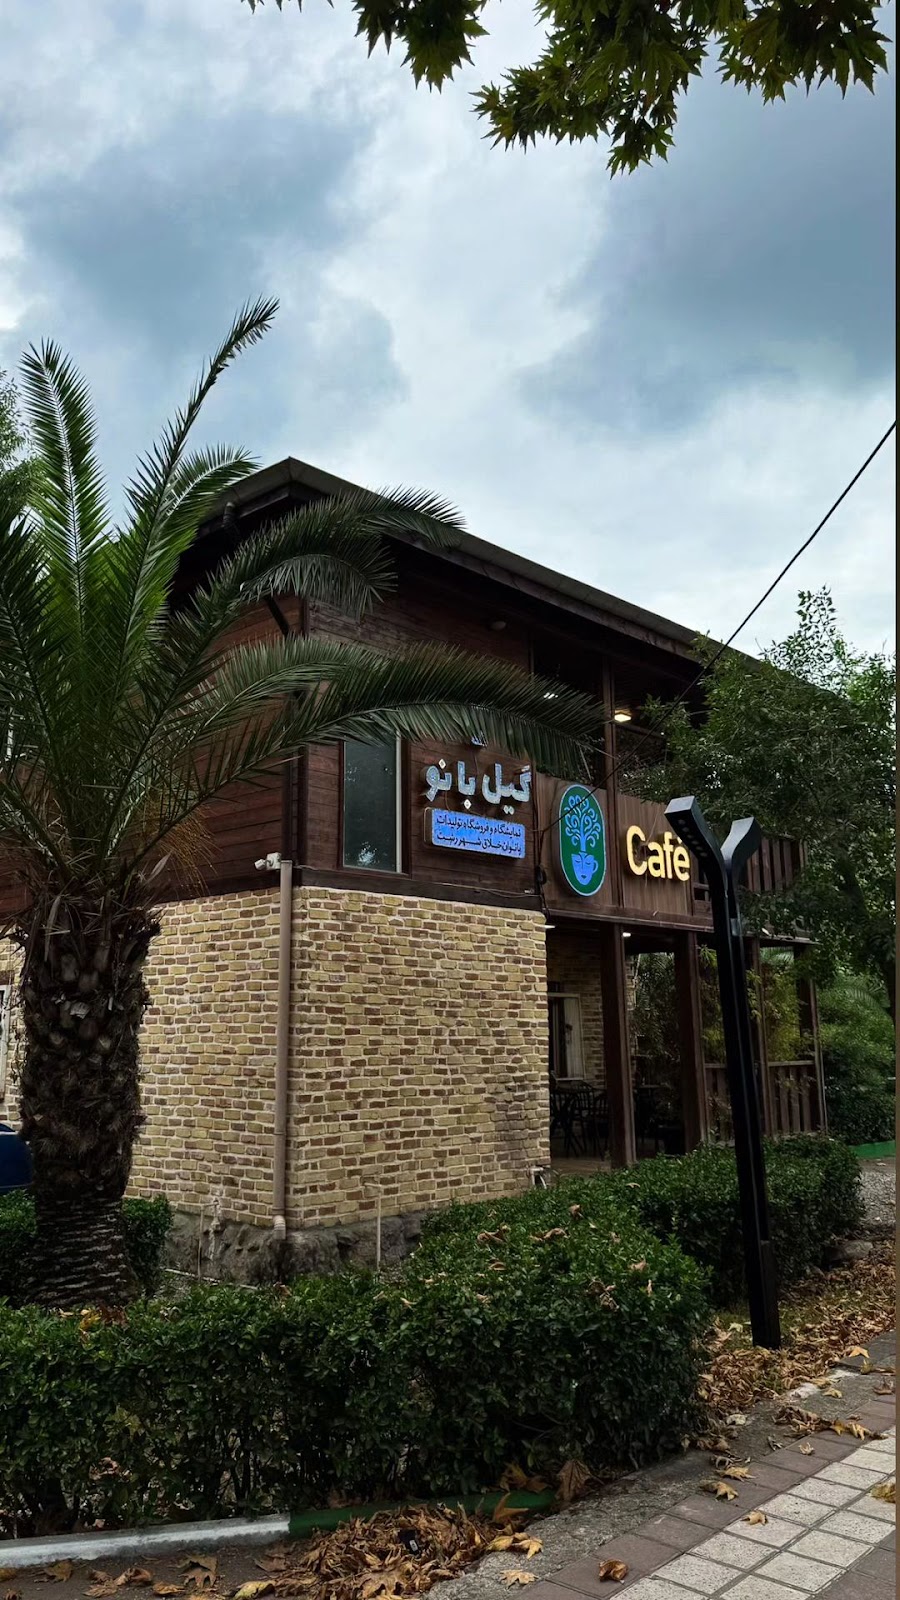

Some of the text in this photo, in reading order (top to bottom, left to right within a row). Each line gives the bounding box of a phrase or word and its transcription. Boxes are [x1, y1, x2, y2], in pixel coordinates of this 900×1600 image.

[482, 763, 532, 815] گیل
[436, 814, 463, 829] تولیدات
[463, 819, 490, 834] فروشگاه
[494, 824, 521, 839] نمایشگاه
[437, 832, 522, 855] بانوان خلاق شهر رشت
